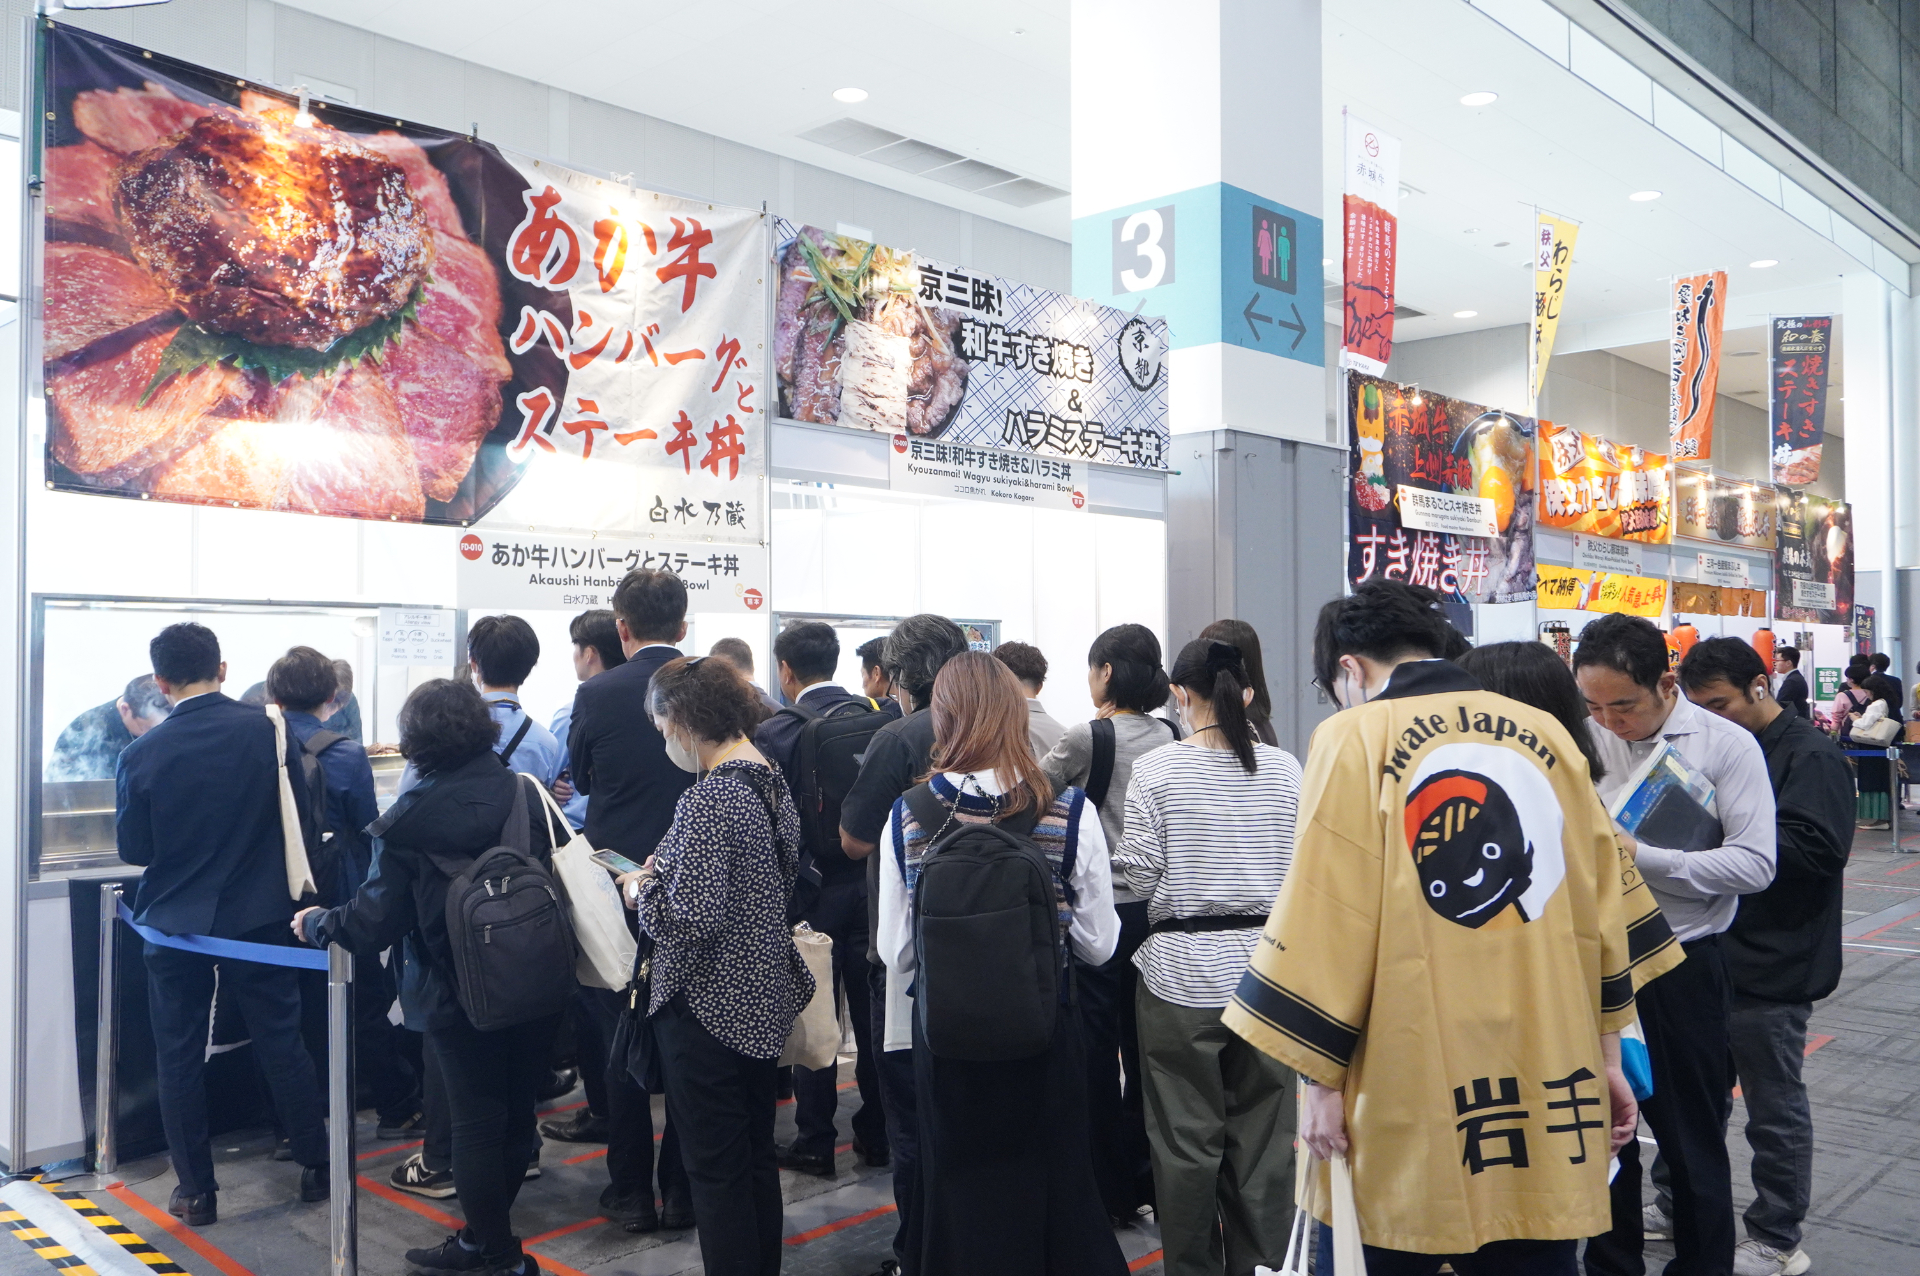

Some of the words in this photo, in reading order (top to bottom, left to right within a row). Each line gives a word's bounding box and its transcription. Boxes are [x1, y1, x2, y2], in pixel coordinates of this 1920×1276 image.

[1357, 163, 1384, 186] 赤城牛
[511, 185, 717, 313] あか牛
[1120, 209, 1166, 292] 3
[1540, 229, 1551, 267] 秩父
[1547, 239, 1569, 319] わらじ
[513, 310, 754, 412] ハンバーグと
[961, 318, 1094, 384] 和牛すき焼き
[1132, 328, 1150, 383] 京都
[1068, 388, 1083, 413] &
[1798, 355, 1823, 438] 焼きすき
[513, 396, 745, 482] ステーキ丼
[1002, 408, 1162, 467] ハラミステーキ丼
[907, 463, 961, 479] Kyouzanmai!
[963, 471, 991, 484] Wagyu
[993, 474, 1055, 492] sukiyaki&harami
[1057, 484, 1075, 493] Bowl
[991, 489, 1013, 499] Kokoro
[1014, 493, 1035, 502] Kogare
[461, 543, 482, 552] FD-010
[492, 542, 740, 577] あか牛ハンバーグとステーキ丼
[1355, 524, 1490, 596] すき焼き丼
[529, 574, 579, 586] Akaushi
[563, 594, 598, 605] 白水乃蔵
[1536, 574, 1577, 596] べて納得
[1620, 585, 1663, 608] 人気急上昇
[1384, 714, 1448, 783] Iwate
[1456, 706, 1556, 770] Japan
[1453, 1066, 1603, 1175] 岩手
[407, 1166, 418, 1182] N
